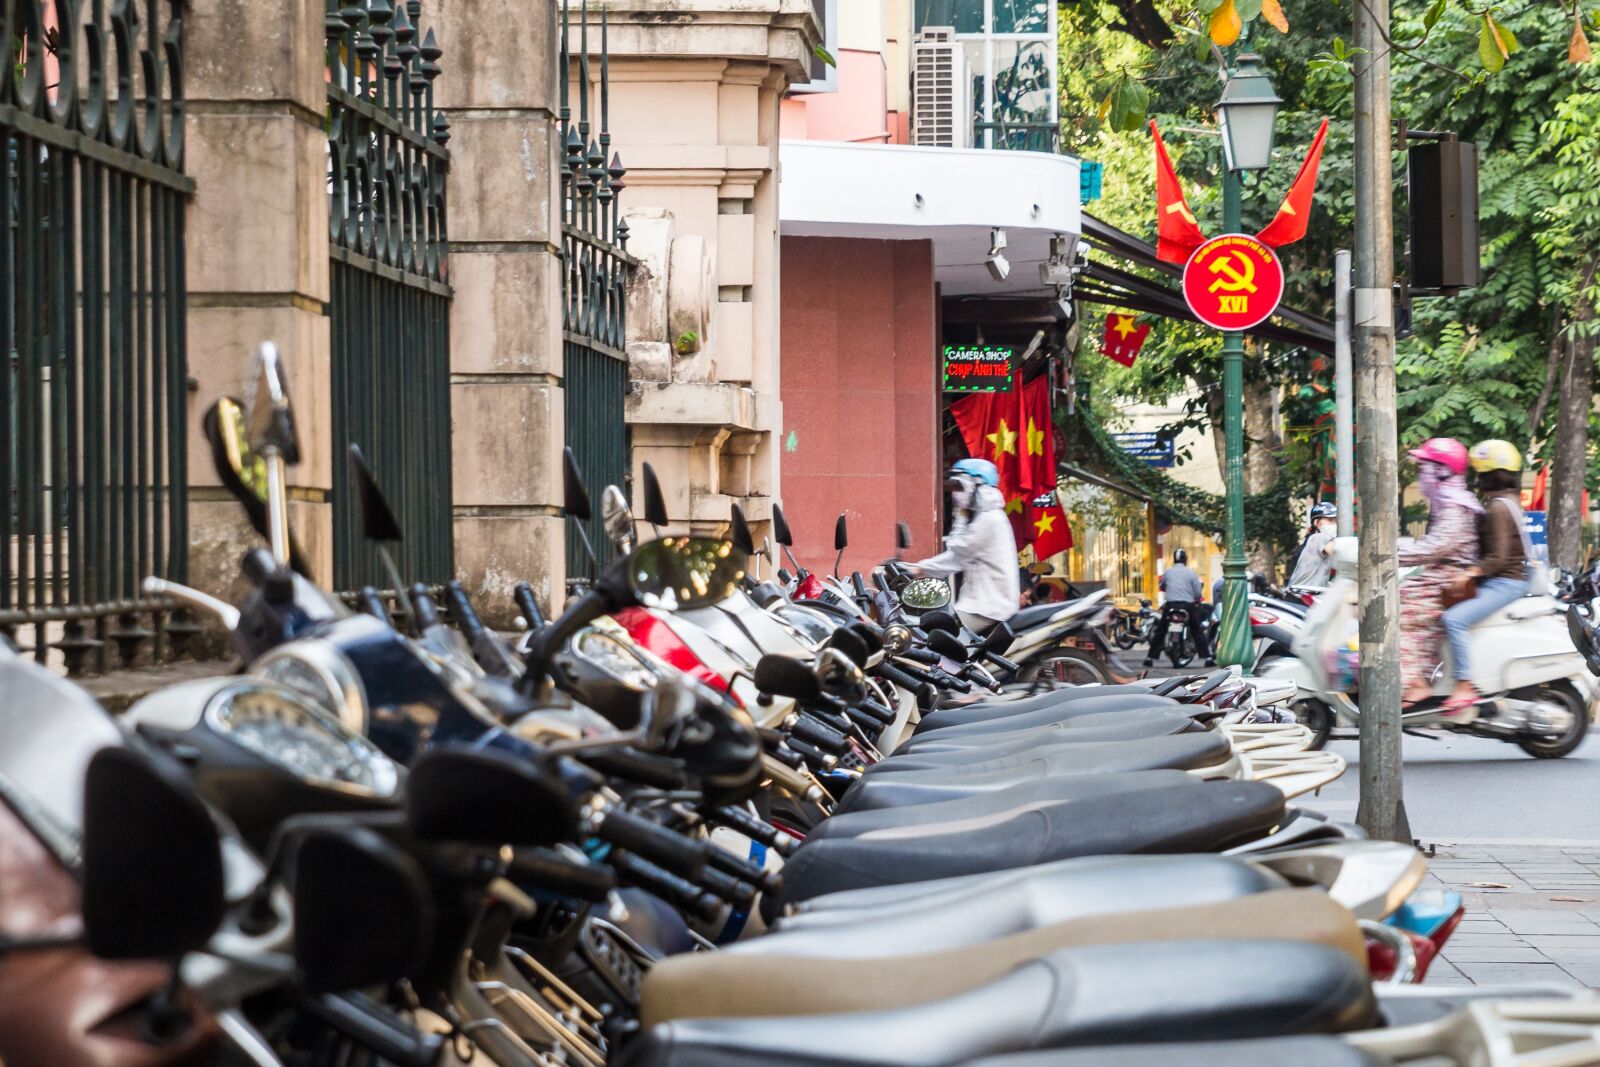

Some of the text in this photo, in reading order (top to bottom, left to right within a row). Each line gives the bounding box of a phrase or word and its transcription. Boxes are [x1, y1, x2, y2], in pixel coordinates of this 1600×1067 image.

[1218, 296, 1248, 313] XVI
[948, 350, 1009, 361] CAMERA SHOP
